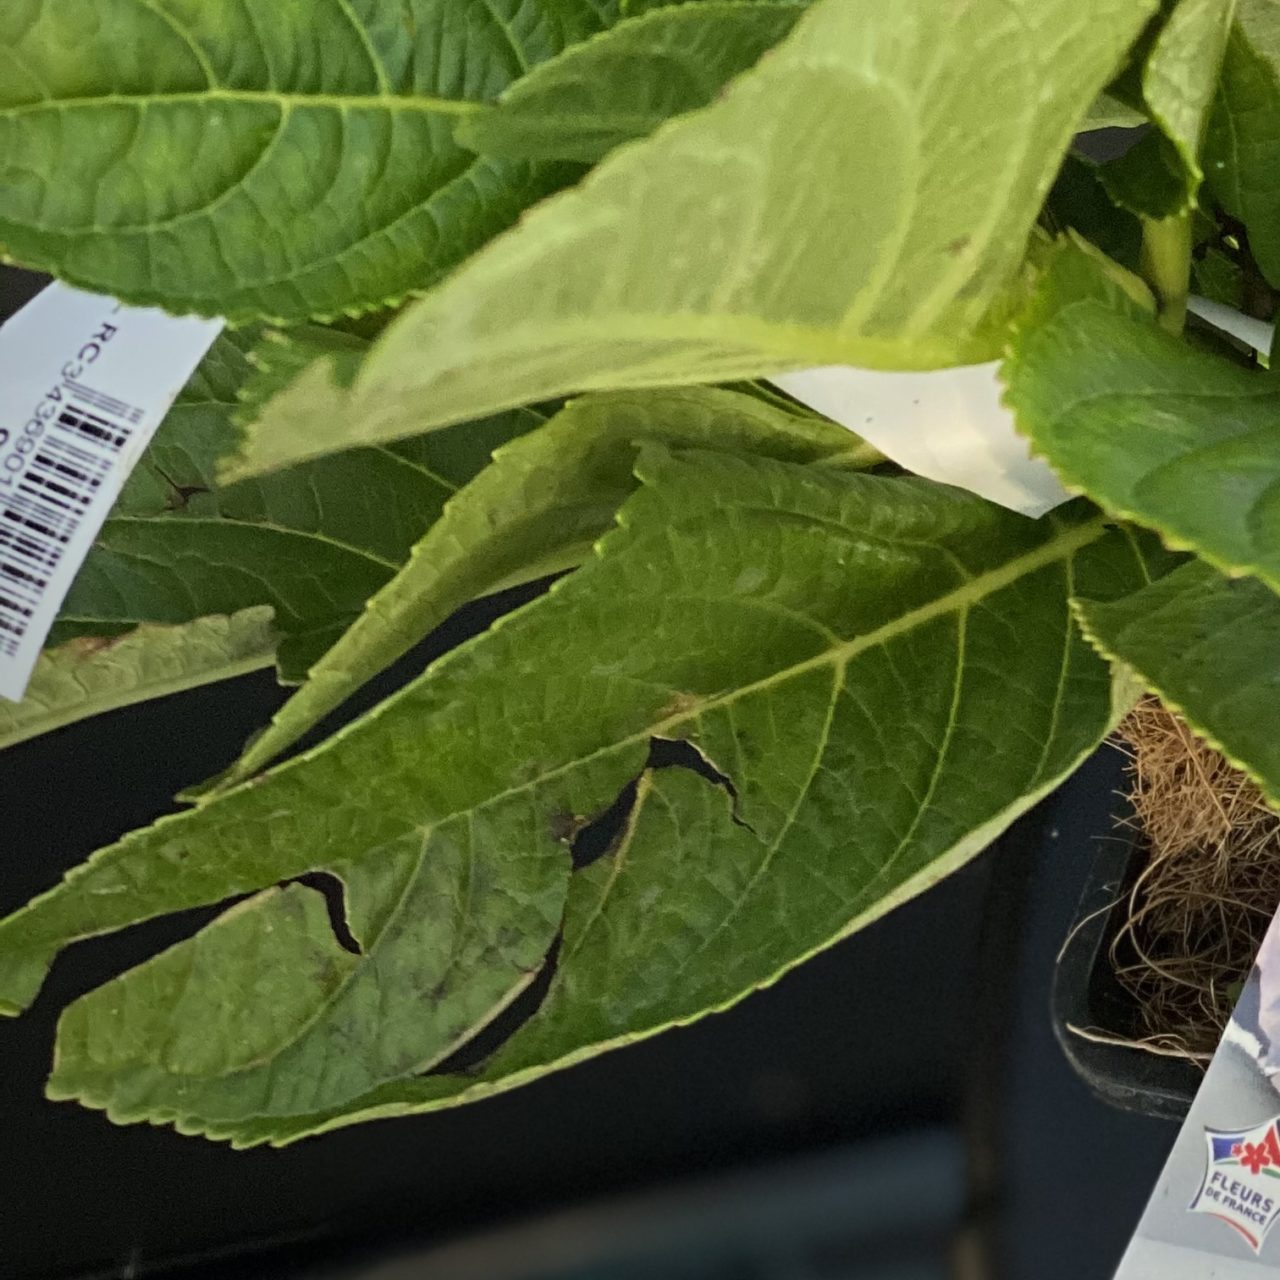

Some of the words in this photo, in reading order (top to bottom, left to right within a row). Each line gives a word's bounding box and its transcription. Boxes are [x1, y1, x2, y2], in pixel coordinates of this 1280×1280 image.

[1204, 1186, 1221, 1201] DE
[1222, 1196, 1268, 1226] FRANCE
[1211, 1171, 1275, 1213] FLEURS
